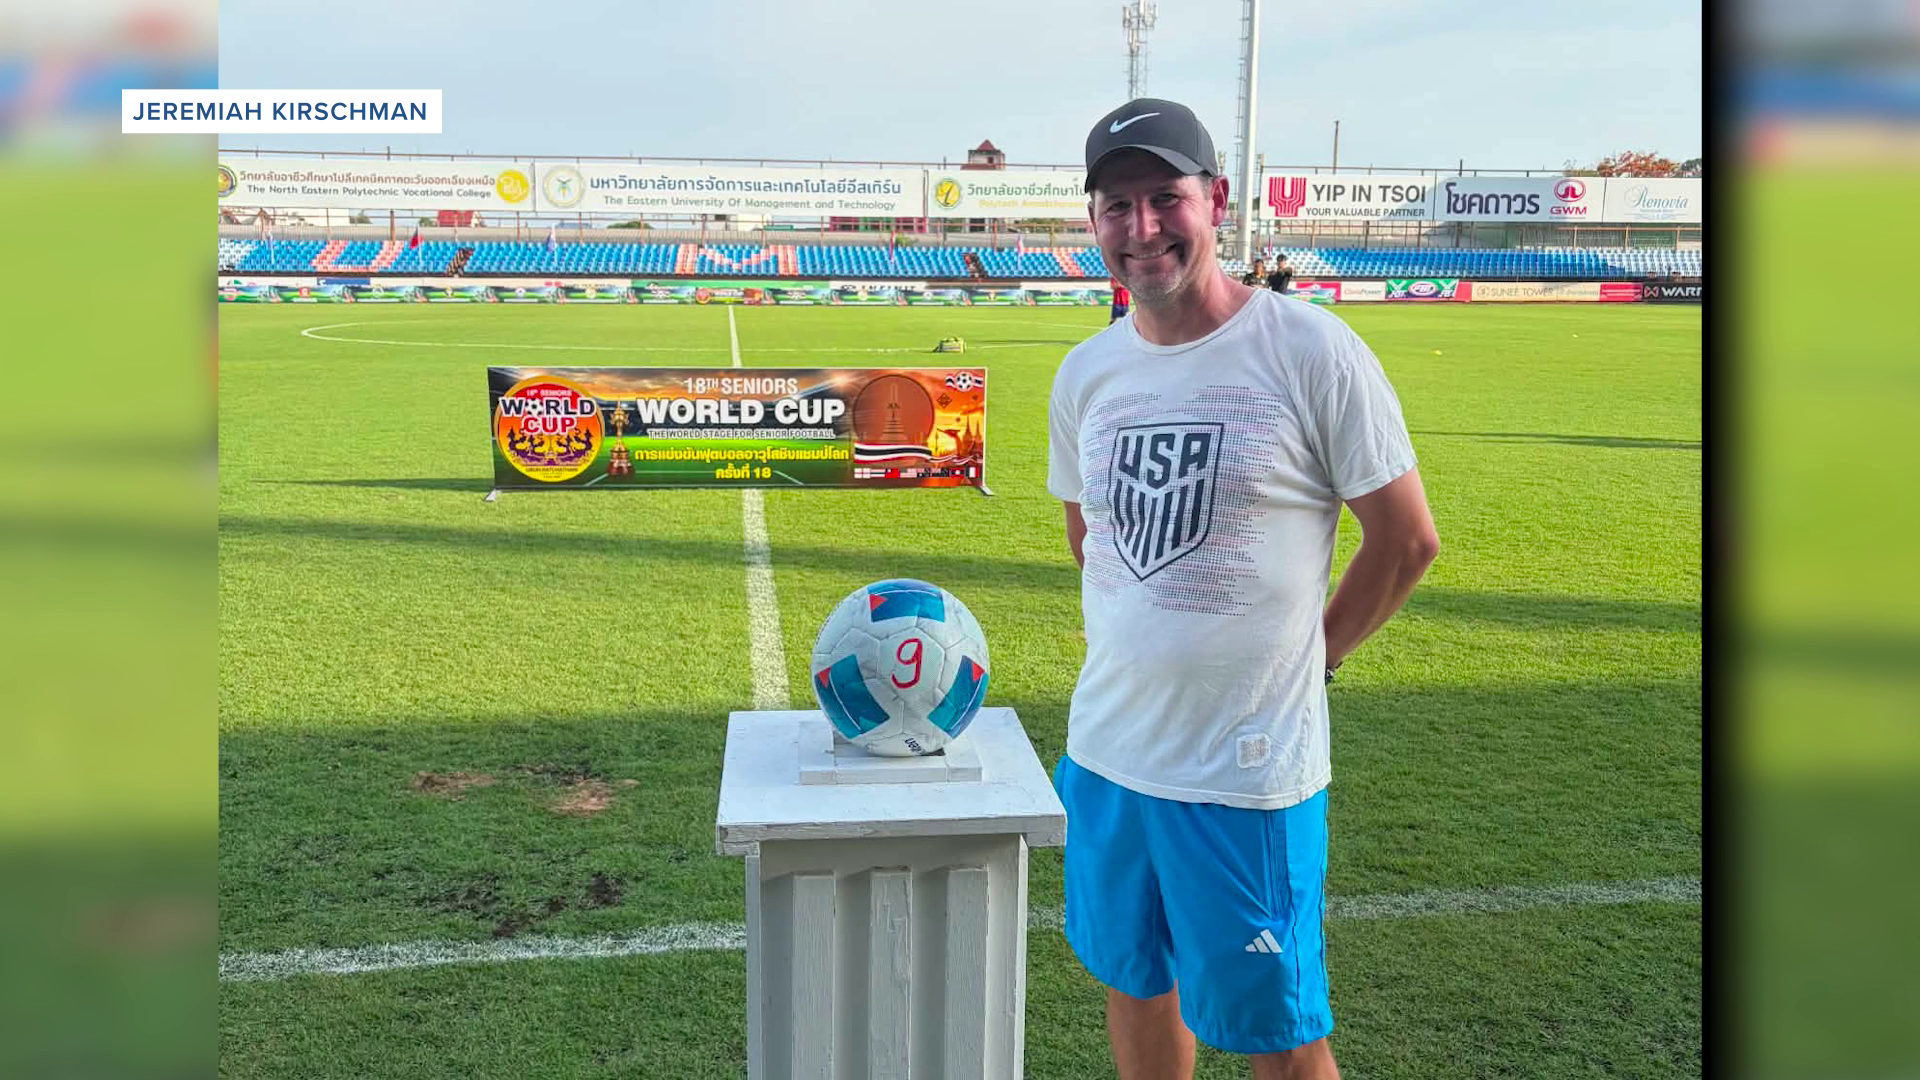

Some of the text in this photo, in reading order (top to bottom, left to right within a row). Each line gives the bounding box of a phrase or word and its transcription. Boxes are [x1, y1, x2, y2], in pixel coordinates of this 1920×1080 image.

[248, 185, 492, 199] The North Eastern Polytechnic Vocational College
[590, 174, 902, 195] มหาวิทยาลัยการจัดการและเทคโนโลยีอีสเทิร์น
[1312, 184, 1426, 203] YIP IN TSOI
[604, 195, 896, 212] The Eastern University Of Management and Technology
[1445, 181, 1540, 216] โชคถาวร
[1627, 184, 1689, 209] Renovia
[1306, 207, 1426, 217] YOUR VALUABLE PARTNER
[1550, 205, 1588, 215] GWM
[684, 377, 798, 395] 18TH SENIORS
[635, 397, 846, 425] WORLD CUP
[523, 416, 575, 433] CUP
[648, 429, 836, 439] THE WORLD STAGE FOR SENIOR FOOTBALL
[635, 445, 850, 464] การแข่งขันฟุตบอลอาวุโสชิงแชมป์โลก
[1118, 432, 1212, 490] USA
[715, 462, 772, 479] ครั้งที่ 18
[891, 637, 924, 689] 9
